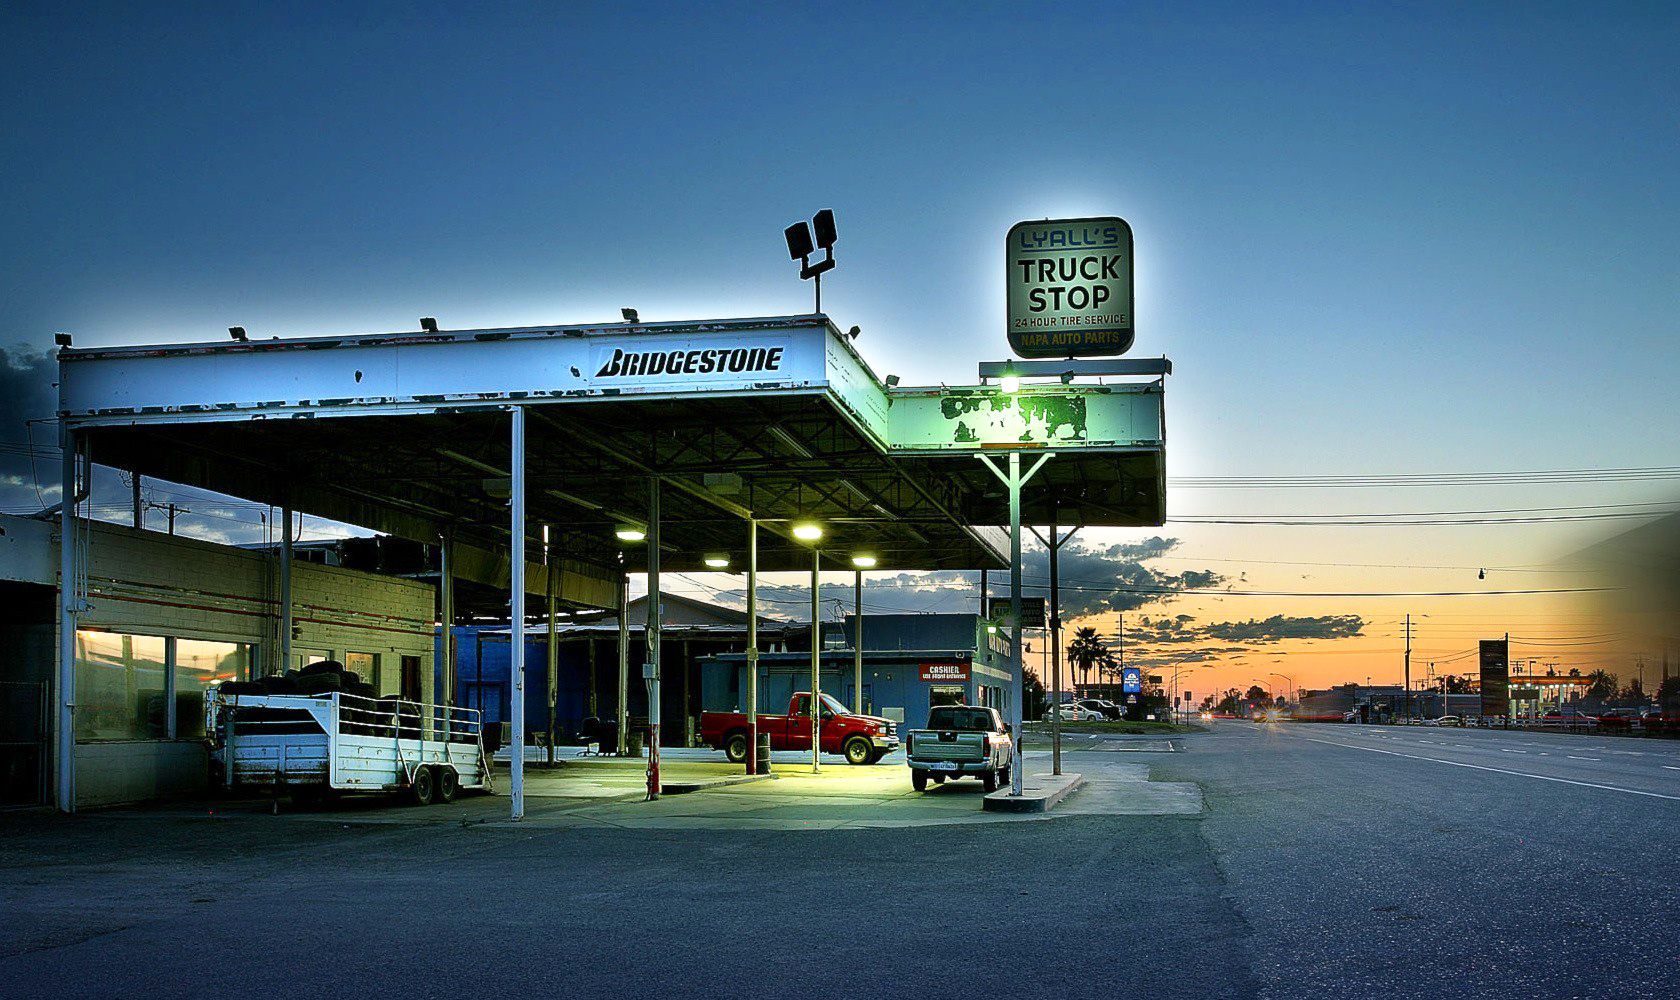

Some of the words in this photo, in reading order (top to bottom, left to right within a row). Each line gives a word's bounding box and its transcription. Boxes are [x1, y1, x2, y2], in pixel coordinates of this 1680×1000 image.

[1020, 228, 1119, 248] LYALL'S
[1018, 255, 1122, 283] TRUCK
[1028, 285, 1110, 312] STOP
[1015, 318, 1027, 327] 24
[1030, 317, 1056, 327] HOUR
[1060, 316, 1081, 326] TIRE
[1084, 314, 1126, 325] SERVICE
[1021, 335, 1049, 346] NAPA
[1052, 333, 1081, 344] AUTO
[1084, 332, 1120, 343] PARTS
[595, 347, 784, 377] BRIDGESTONE
